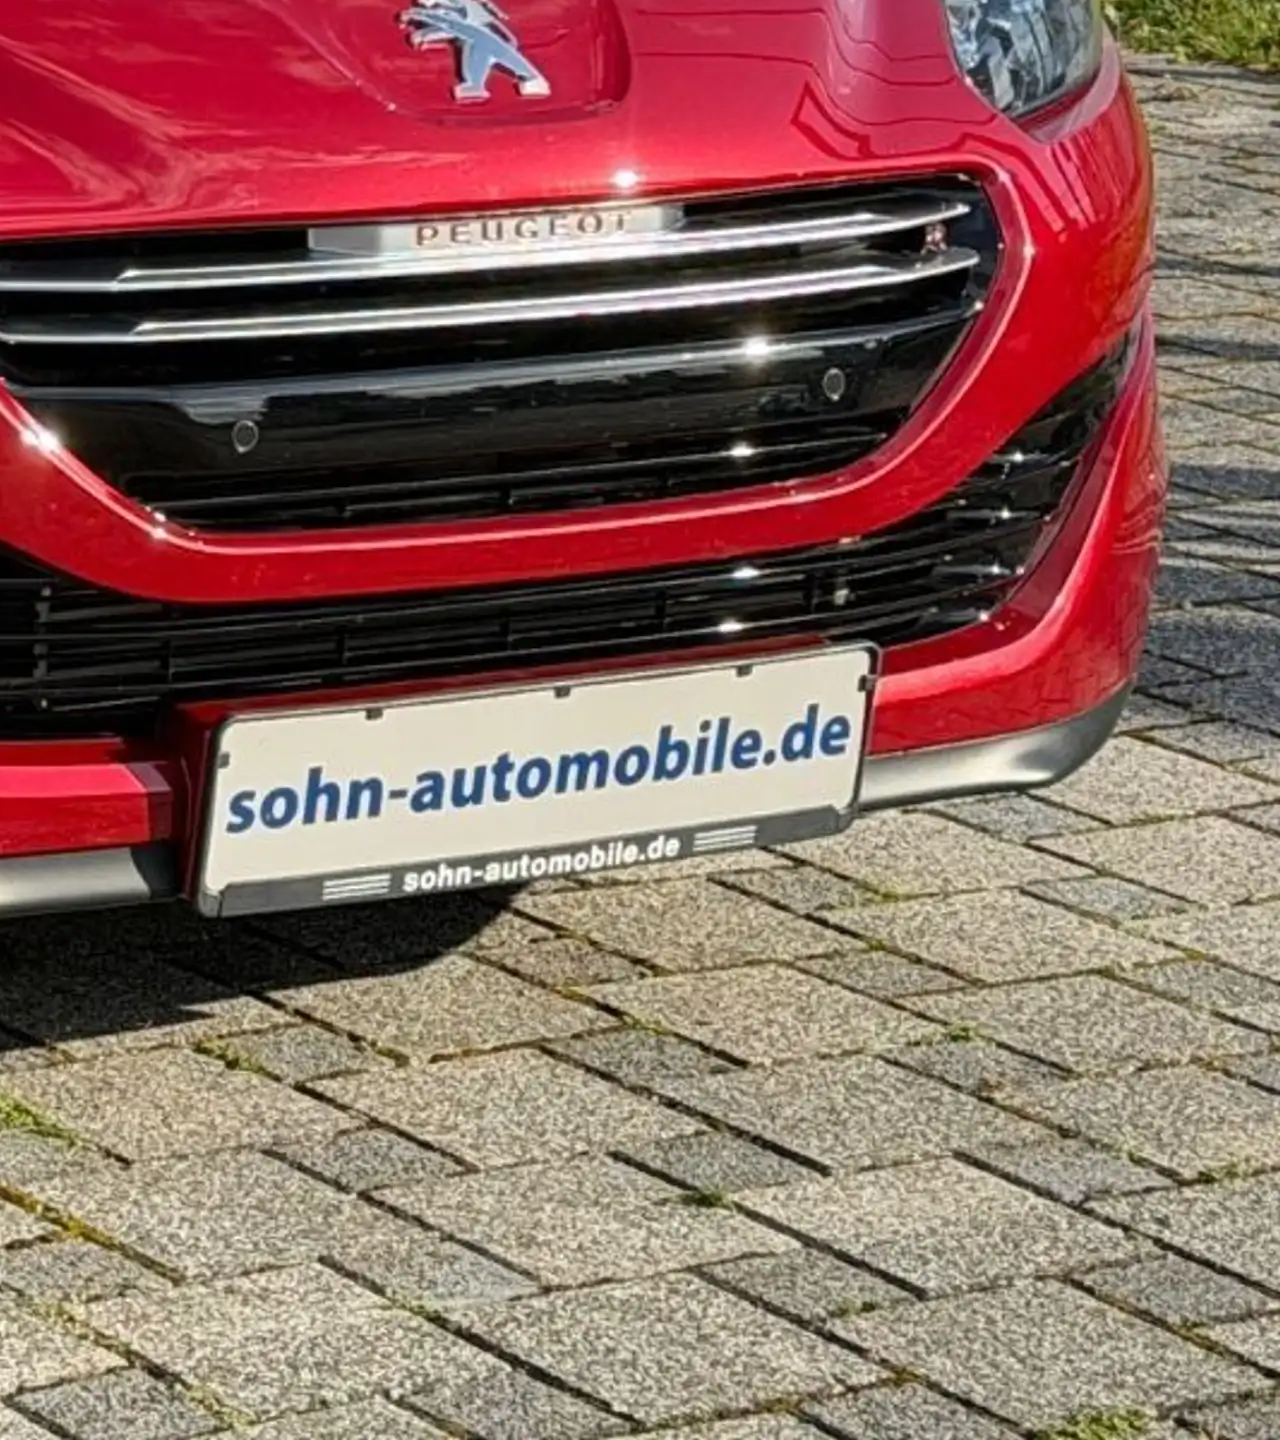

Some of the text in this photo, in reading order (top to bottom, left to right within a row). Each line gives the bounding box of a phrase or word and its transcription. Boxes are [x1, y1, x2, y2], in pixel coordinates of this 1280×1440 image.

[415, 211, 632, 246] PEUGEOT
[224, 703, 852, 834] sohn-automobile.de
[402, 832, 681, 893] sohn-automobile.de
